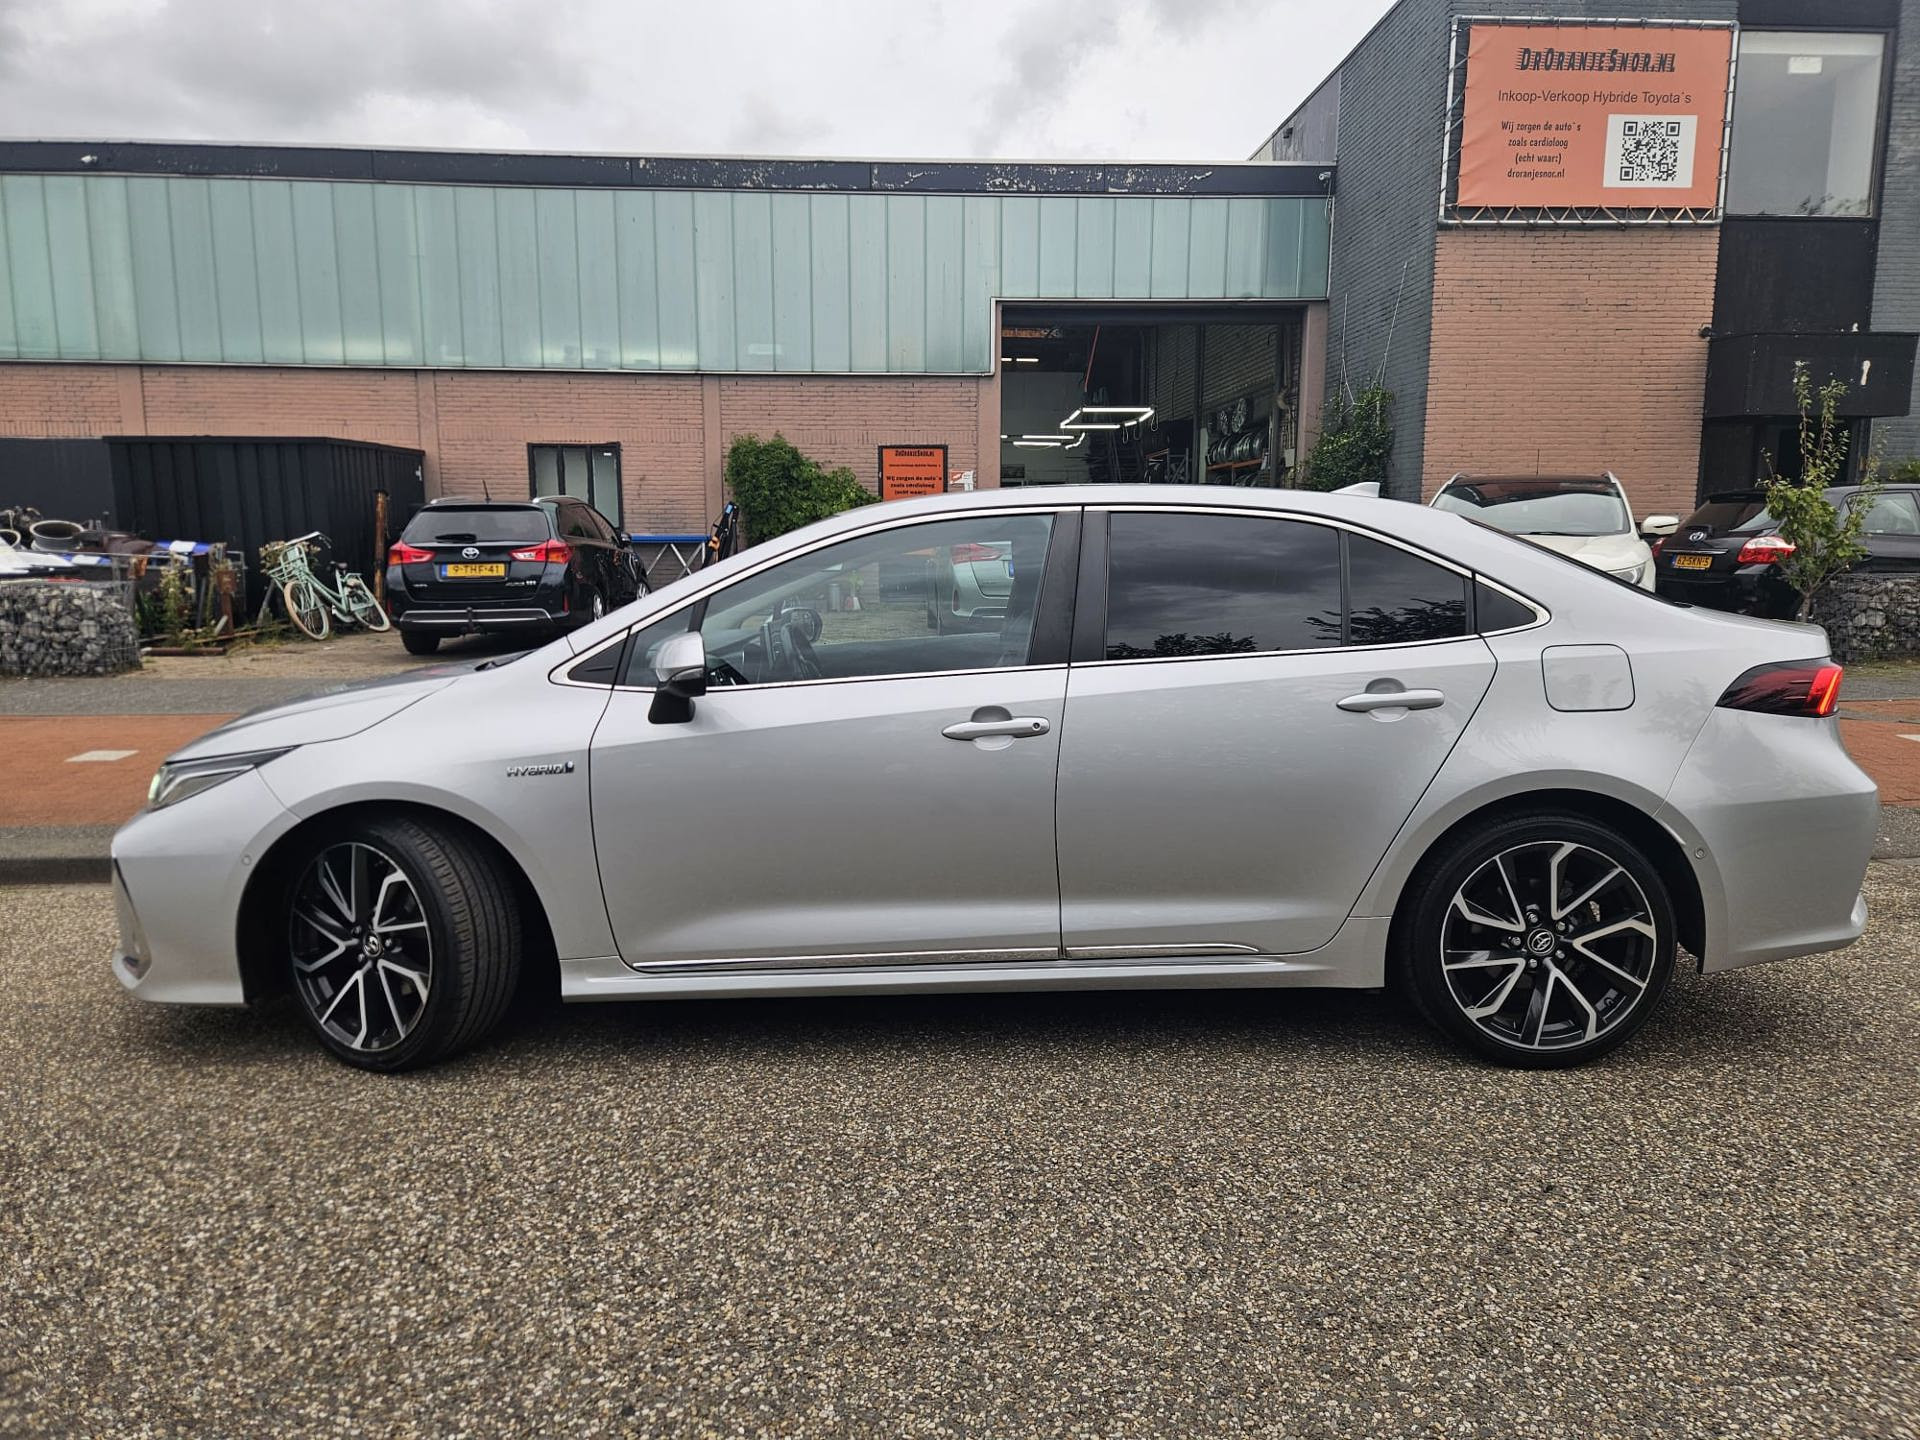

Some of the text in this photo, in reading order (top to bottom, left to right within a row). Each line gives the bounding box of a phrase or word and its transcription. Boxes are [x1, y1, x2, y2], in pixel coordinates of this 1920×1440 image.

[1498, 90, 1590, 104] Inkoop-Verkoop
[1593, 90, 1638, 105] Hybride
[1501, 121, 1514, 133] Wij
[1516, 123, 1541, 133] zorgen
[1543, 122, 1553, 131] de
[1508, 137, 1569, 149] zoals cardioloog
[1515, 153, 1535, 165] (echt
[1507, 168, 1565, 180] droranjesnor.nl
[507, 764, 564, 777] HYBRID
